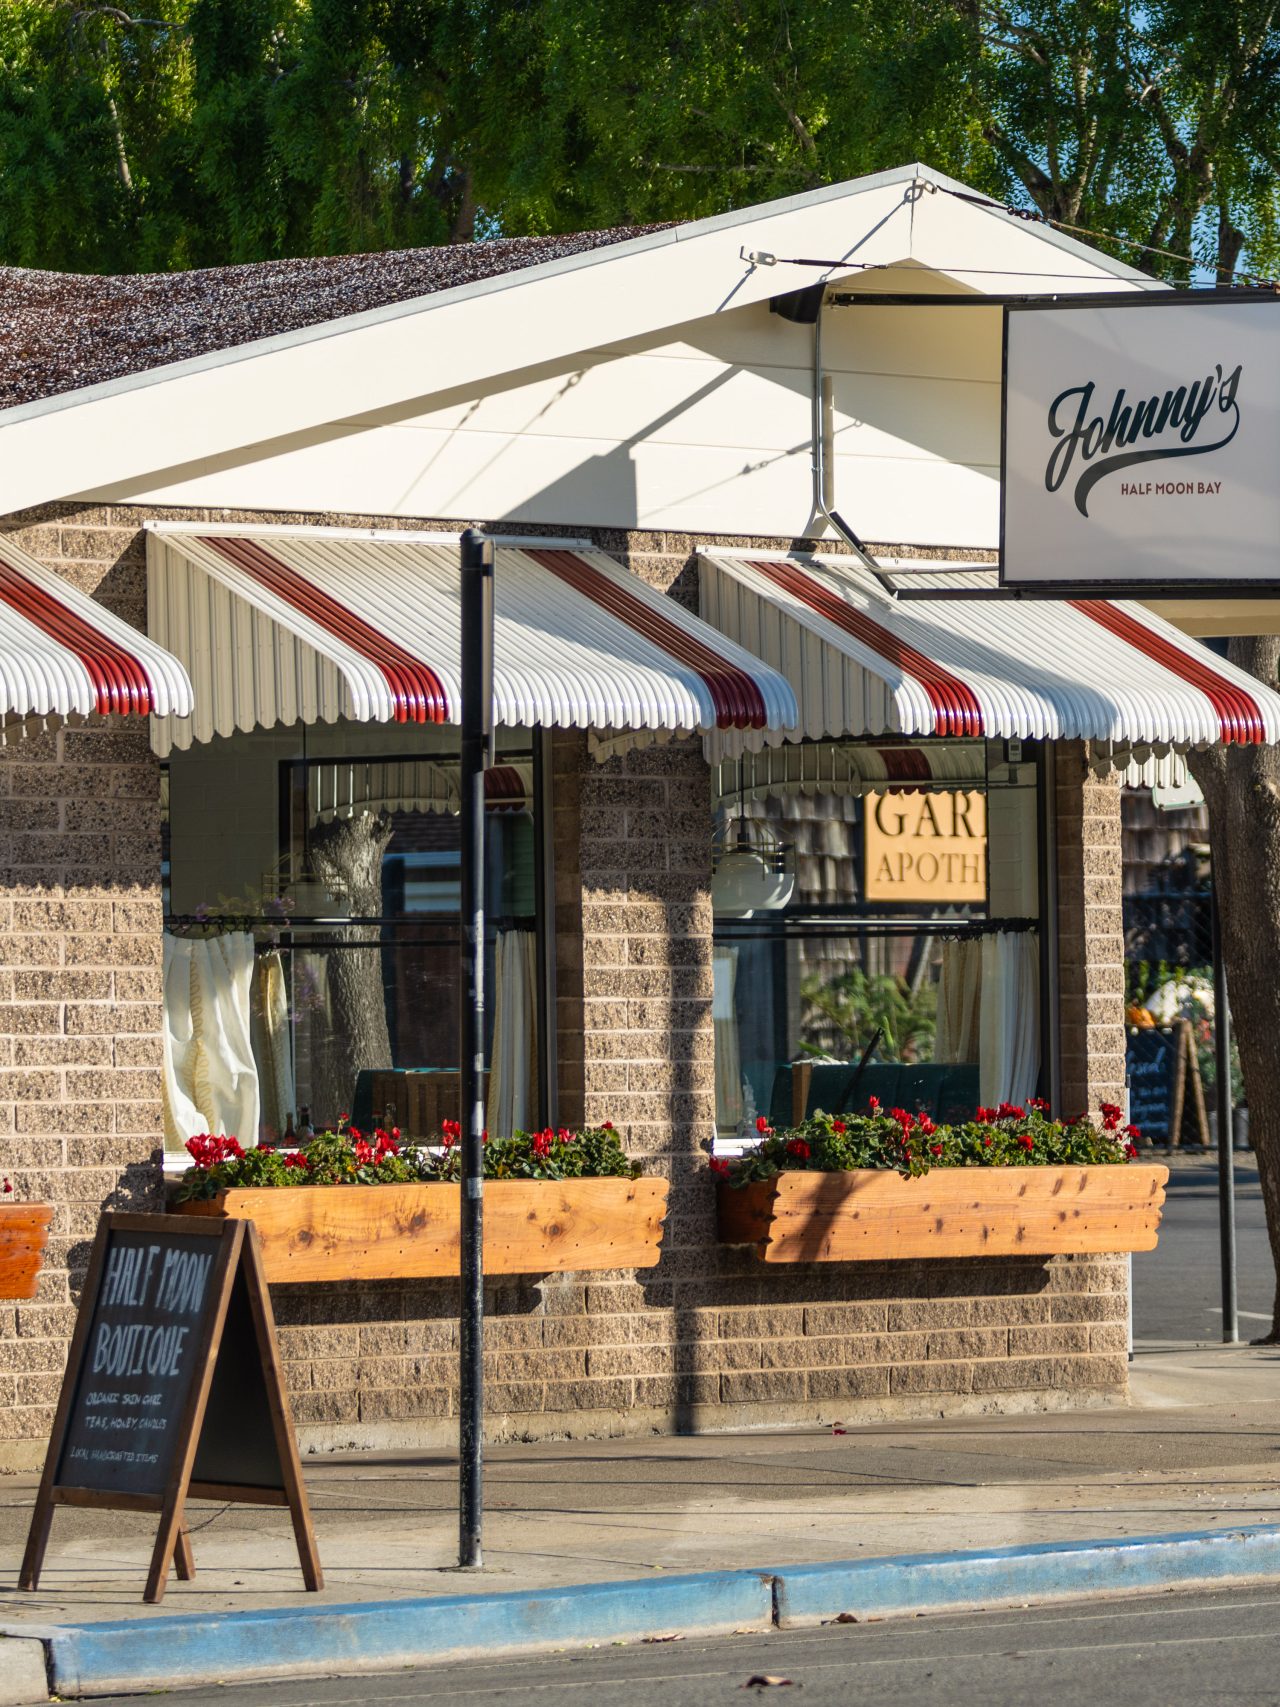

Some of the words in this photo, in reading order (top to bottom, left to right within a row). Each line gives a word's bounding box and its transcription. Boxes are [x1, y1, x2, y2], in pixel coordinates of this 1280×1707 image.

[1044, 363, 1243, 493] Johnny's
[1120, 482, 1153, 496] HALF
[1155, 482, 1194, 496] MOON
[1197, 481, 1222, 495] BAY
[874, 788, 987, 838] GAR
[875, 851, 987, 884] APOTH
[101, 1245, 160, 1307] HALF
[155, 1248, 212, 1314] MOON
[93, 1322, 190, 1377] BOUTIQUE
[121, 1393, 140, 1405] SKIN
